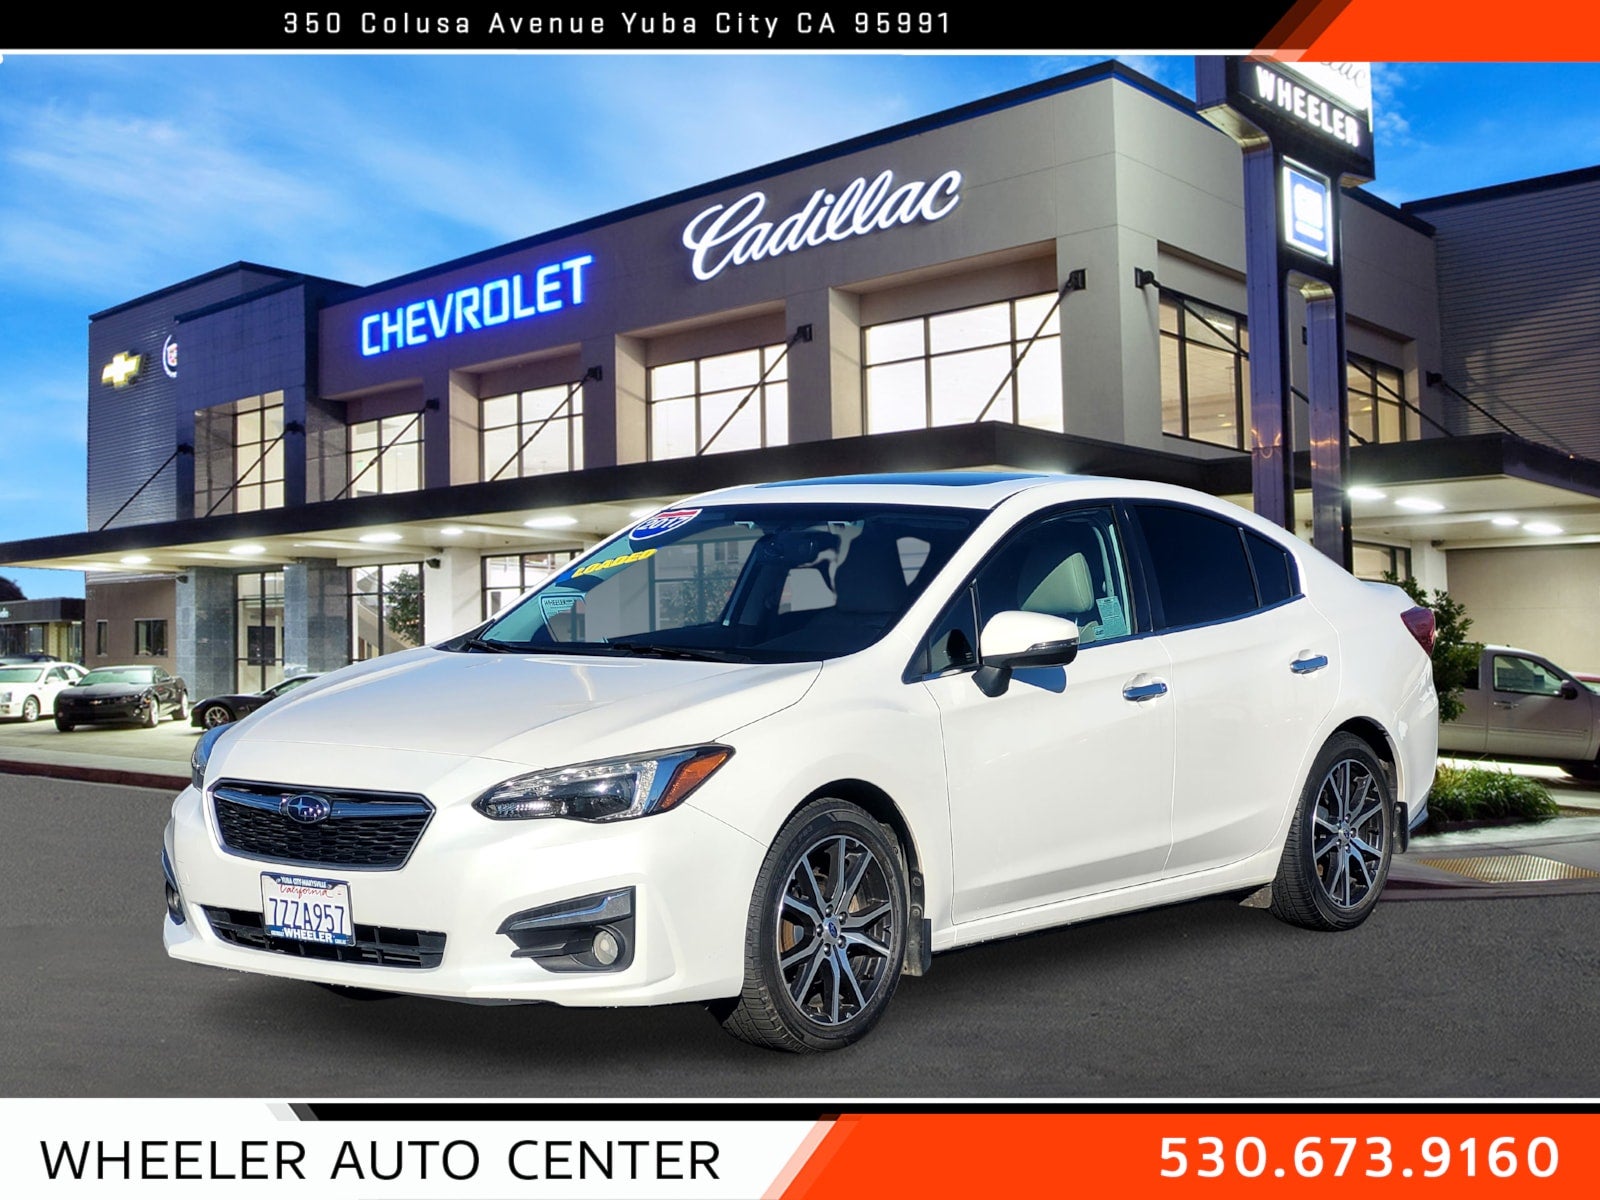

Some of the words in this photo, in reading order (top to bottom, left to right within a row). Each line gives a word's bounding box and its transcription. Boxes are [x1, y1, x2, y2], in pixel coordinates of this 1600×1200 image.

[1255, 65, 1360, 148] WHEELER
[682, 168, 962, 281] Cadillac
[361, 254, 594, 357] CHEVROLET
[636, 516, 690, 531] 2017
[571, 548, 658, 579] LOADED
[268, 897, 345, 935] 7ZZA957
[283, 927, 334, 944] WHEELER
